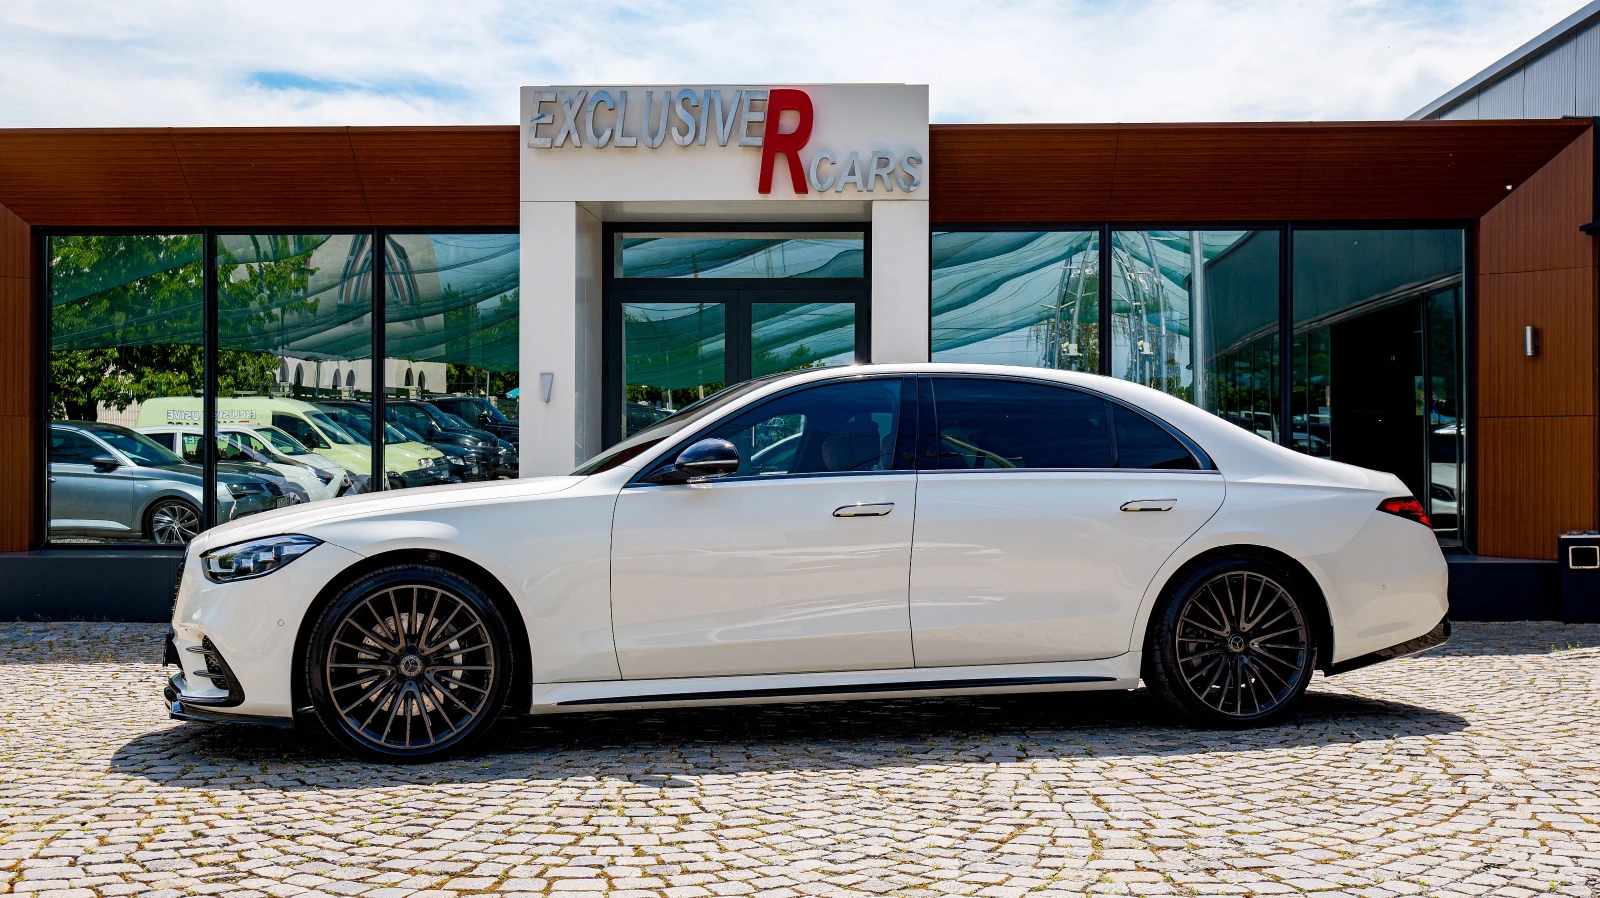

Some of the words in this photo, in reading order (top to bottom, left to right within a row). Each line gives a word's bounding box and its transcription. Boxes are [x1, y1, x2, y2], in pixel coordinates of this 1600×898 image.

[528, 89, 767, 149] EXCLUSIVE
[758, 88, 814, 195] R
[809, 150, 923, 193] CARS
